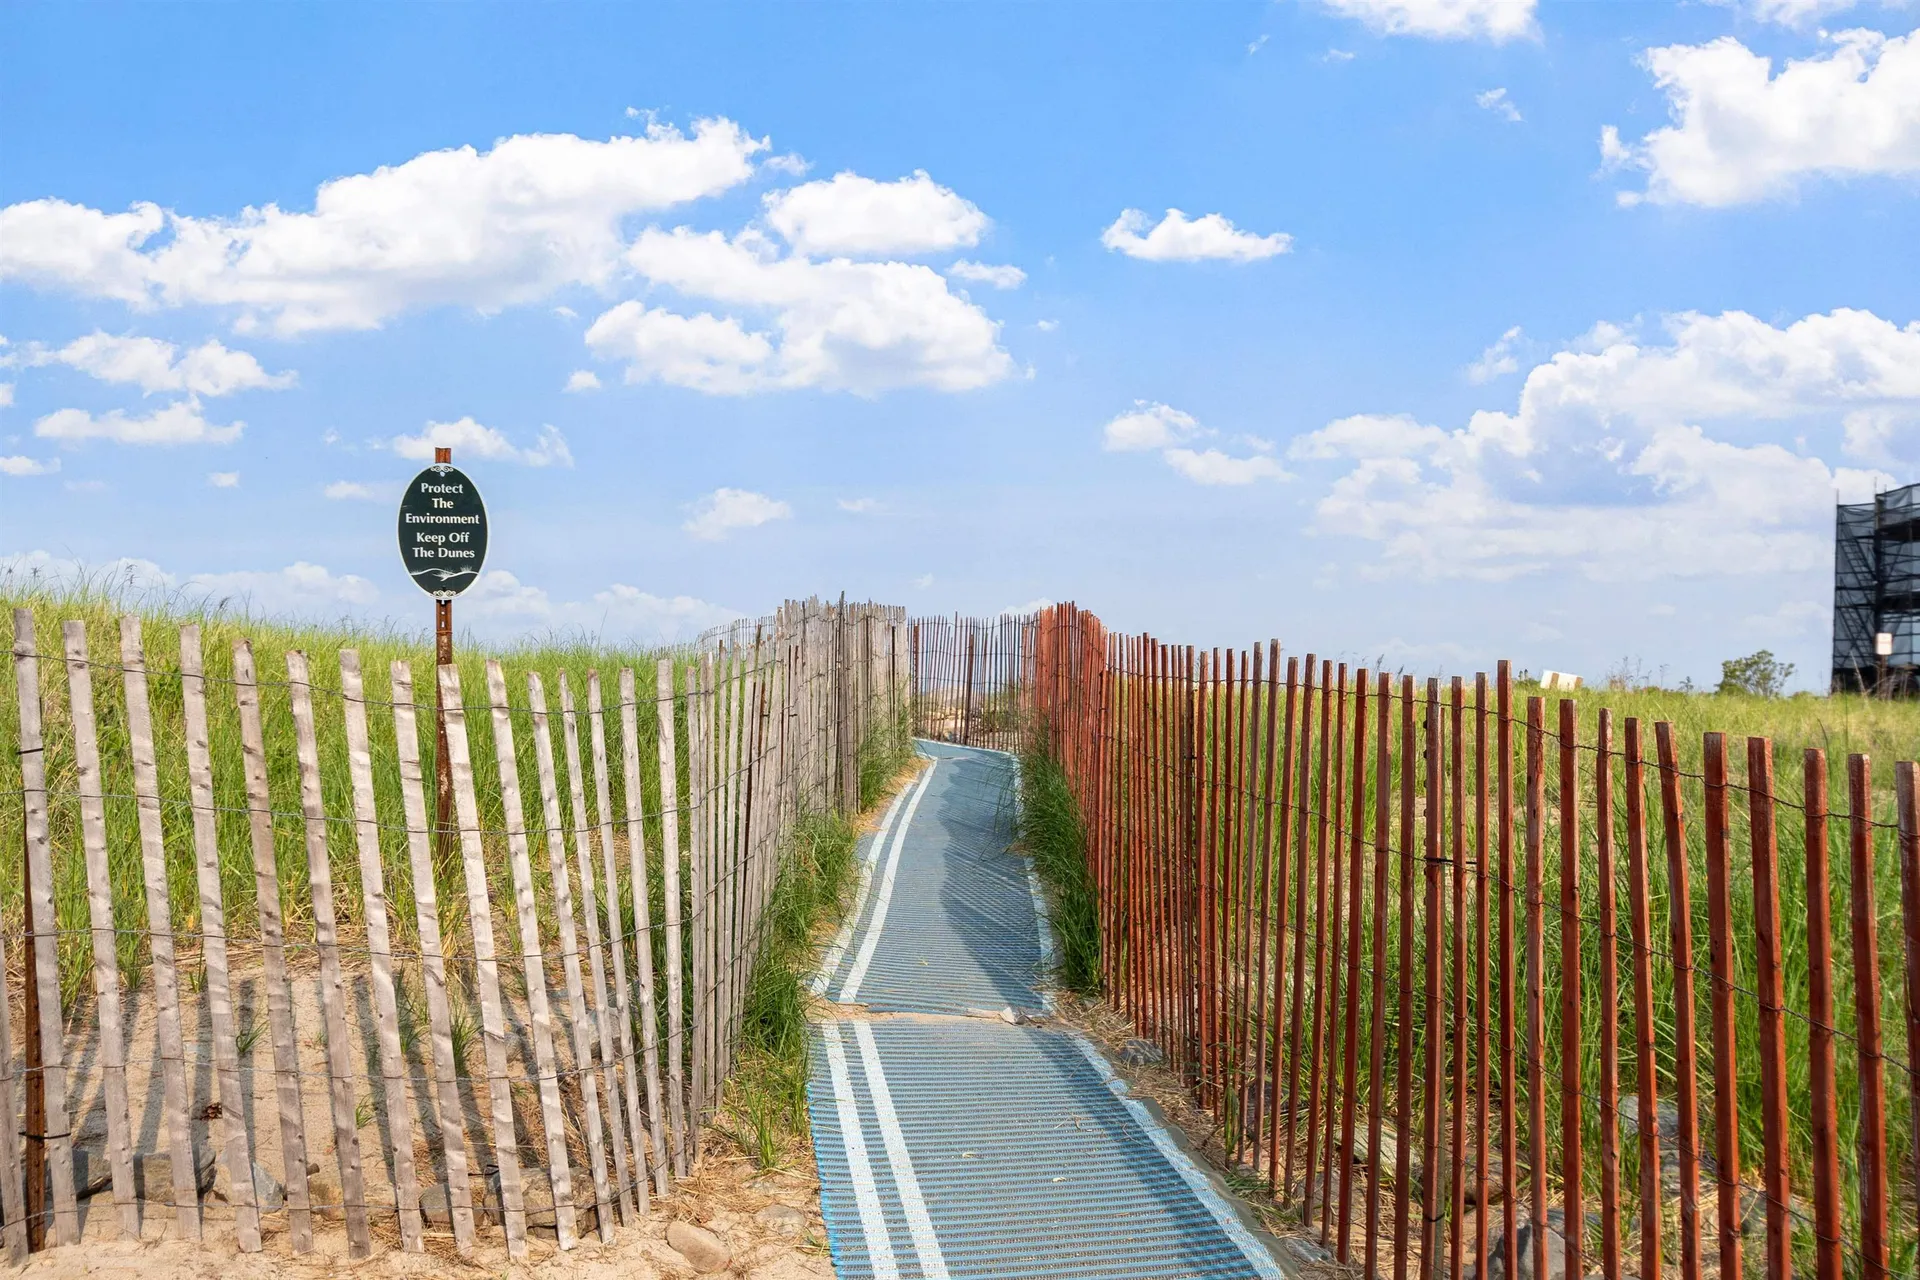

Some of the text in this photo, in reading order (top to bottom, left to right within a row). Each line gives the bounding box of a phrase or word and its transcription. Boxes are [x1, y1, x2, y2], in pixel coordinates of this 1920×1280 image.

[421, 483, 463, 493] Protect
[432, 498, 453, 508] The
[405, 513, 480, 524] Environment
[416, 532, 470, 545] Keep Off
[412, 547, 475, 558] The Dunes
